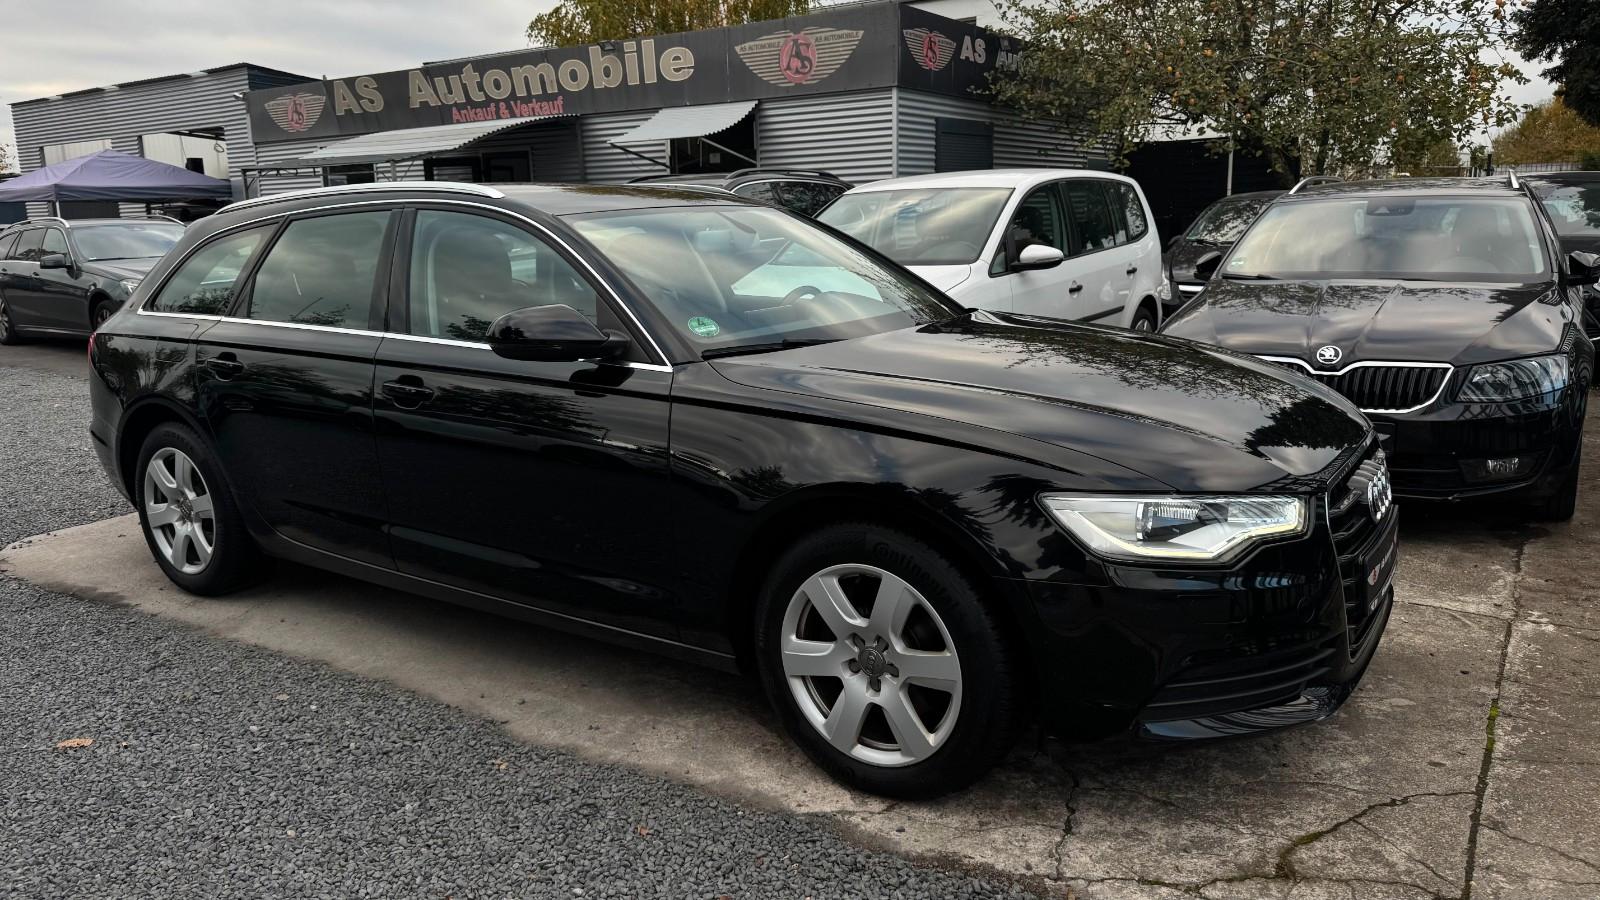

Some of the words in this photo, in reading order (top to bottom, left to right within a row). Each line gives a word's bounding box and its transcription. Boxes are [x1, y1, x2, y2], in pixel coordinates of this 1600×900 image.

[784, 38, 813, 75] AS
[960, 34, 986, 64] AS
[333, 77, 384, 116] AS
[408, 40, 694, 108] Automobile
[452, 101, 498, 124] Ankauf
[500, 101, 511, 119] &
[513, 96, 565, 120] Verkauf
